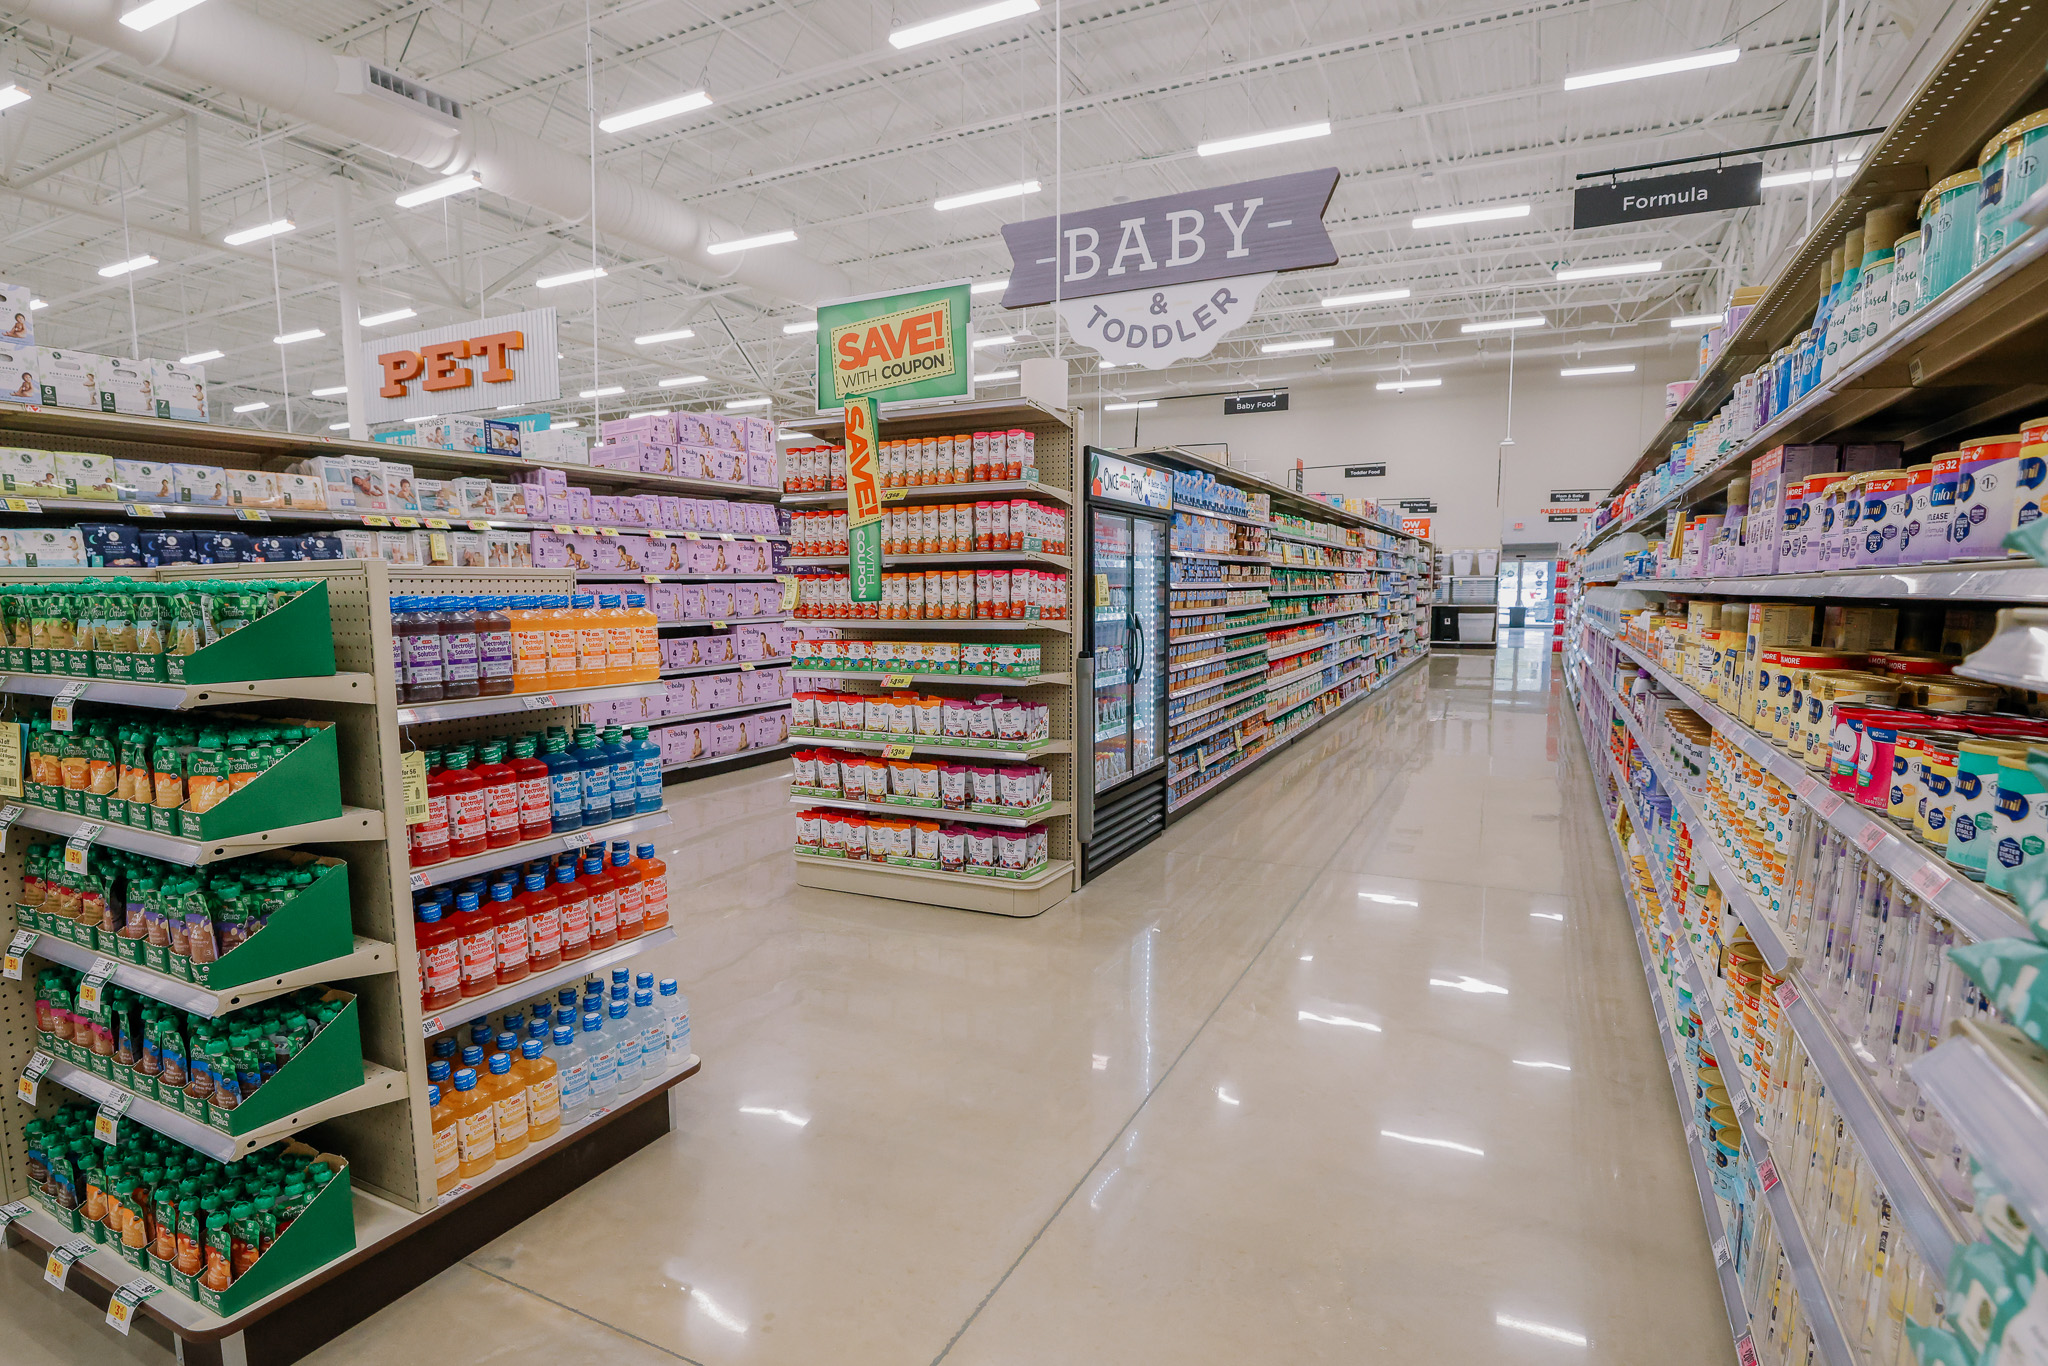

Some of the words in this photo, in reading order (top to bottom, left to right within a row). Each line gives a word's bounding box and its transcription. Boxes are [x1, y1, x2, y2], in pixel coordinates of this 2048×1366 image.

[1622, 186, 1709, 211] Formula
[1063, 197, 1264, 282] BABY
[1086, 288, 1239, 349] TODDLER
[1149, 292, 1168, 315] &
[838, 309, 946, 371] SAVE!
[378, 330, 525, 399] PET
[841, 370, 878, 389] WITH
[881, 353, 946, 381] COUPON
[44, 387, 52, 395] 6
[160, 400, 166, 408] 7
[1236, 402, 1255, 410] Baby
[1257, 400, 1276, 408] Food
[424, 418, 447, 427] HONEST
[845, 405, 879, 519] SAVE!
[540, 548, 544, 556] 3
[856, 529, 868, 600] COUPON
[865, 544, 876, 586] WITH
[1784, 656, 1800, 665] MORE
